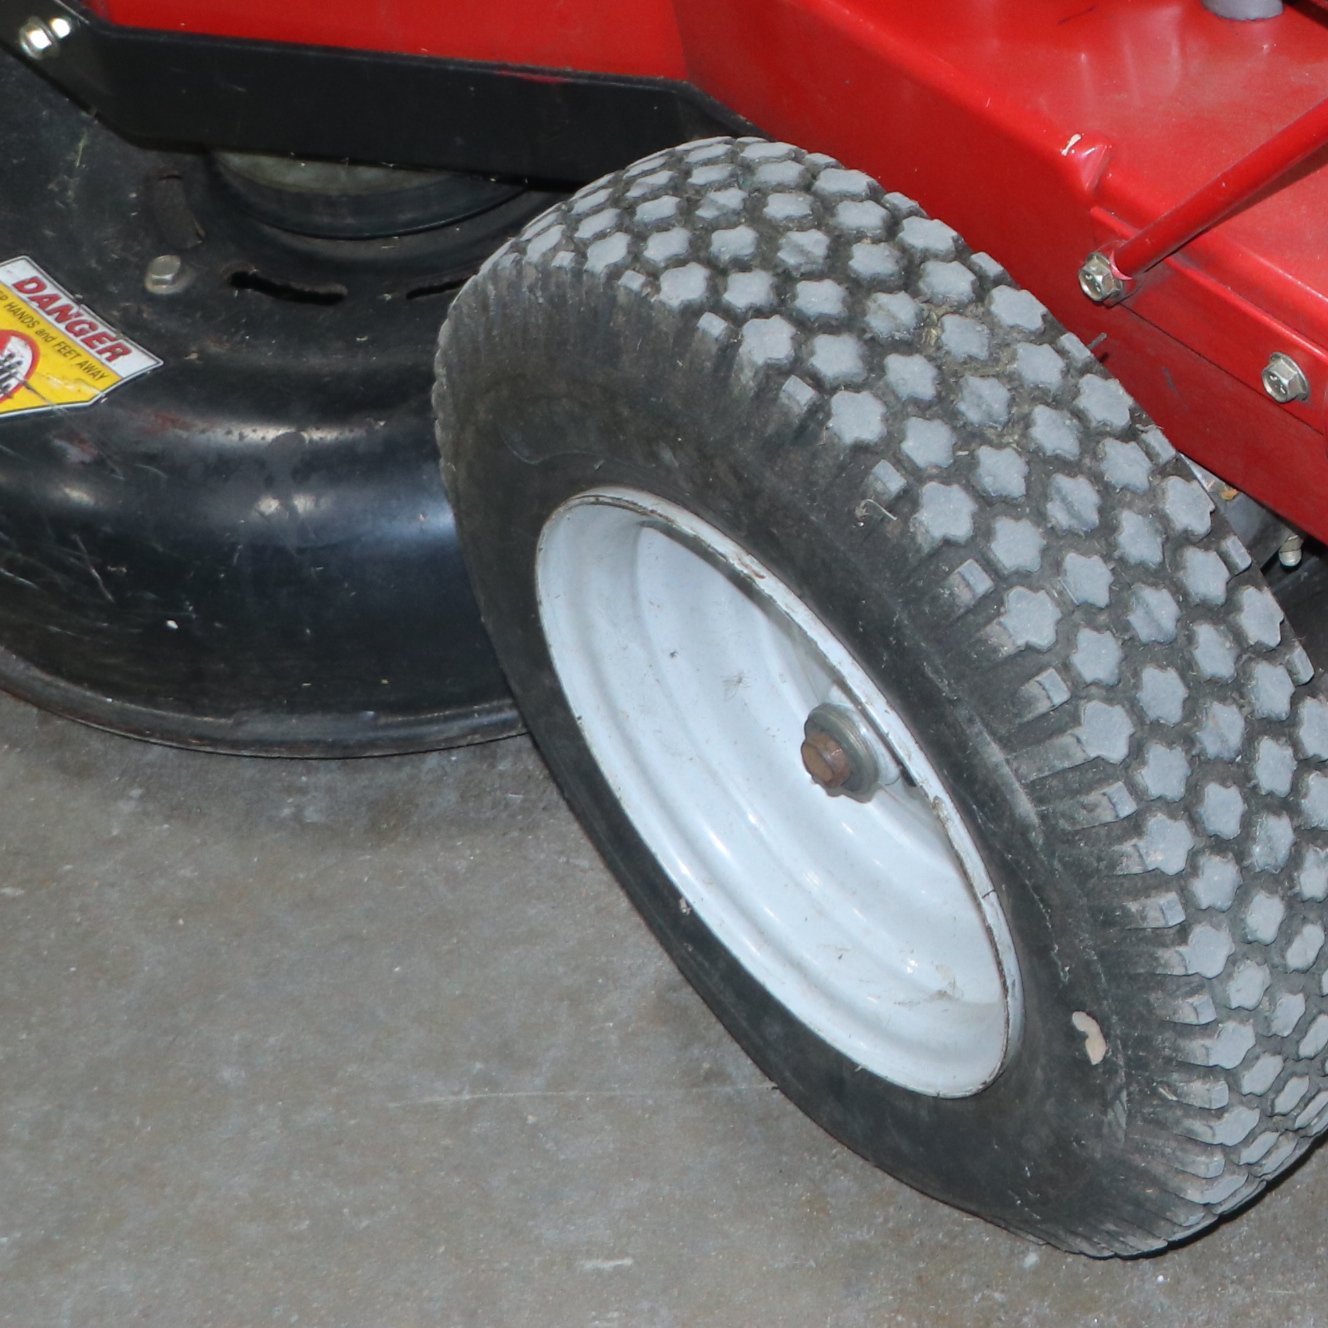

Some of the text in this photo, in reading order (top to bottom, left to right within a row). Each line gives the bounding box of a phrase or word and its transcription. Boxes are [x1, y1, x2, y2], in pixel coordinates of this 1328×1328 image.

[4, 301, 107, 381] HANDS and FEET AWAY
[12, 276, 132, 362] DANGER
